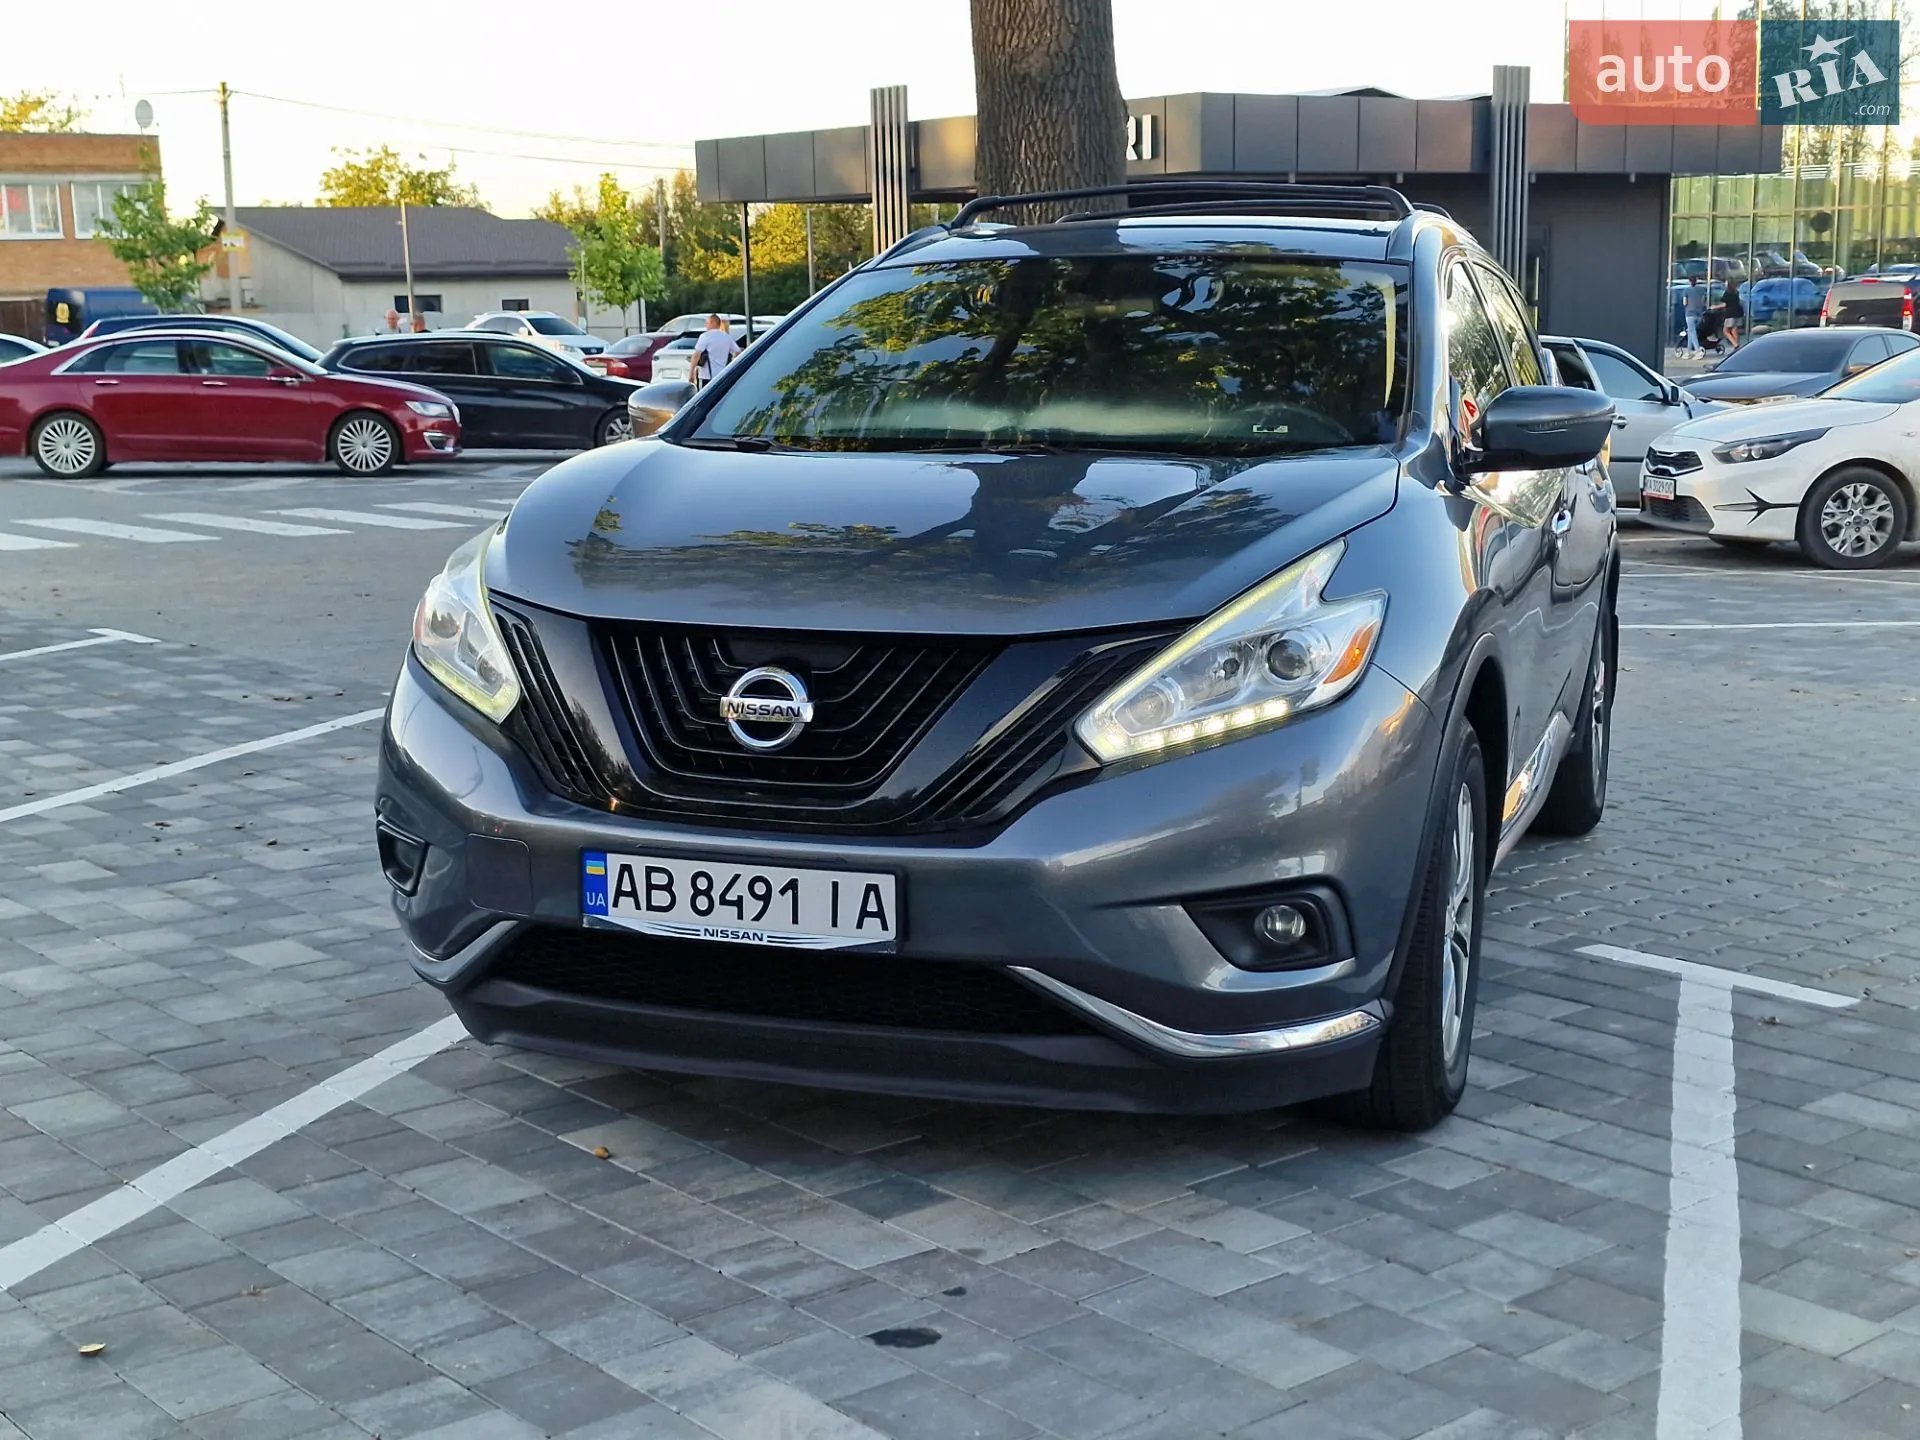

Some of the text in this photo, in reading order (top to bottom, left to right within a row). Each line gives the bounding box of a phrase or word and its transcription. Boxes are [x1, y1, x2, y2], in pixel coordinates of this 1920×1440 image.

[727, 702, 801, 718] NISSAN
[586, 891, 606, 908] UA
[612, 863, 889, 932] AB 8491 IA
[703, 927, 764, 942] NISSAN
